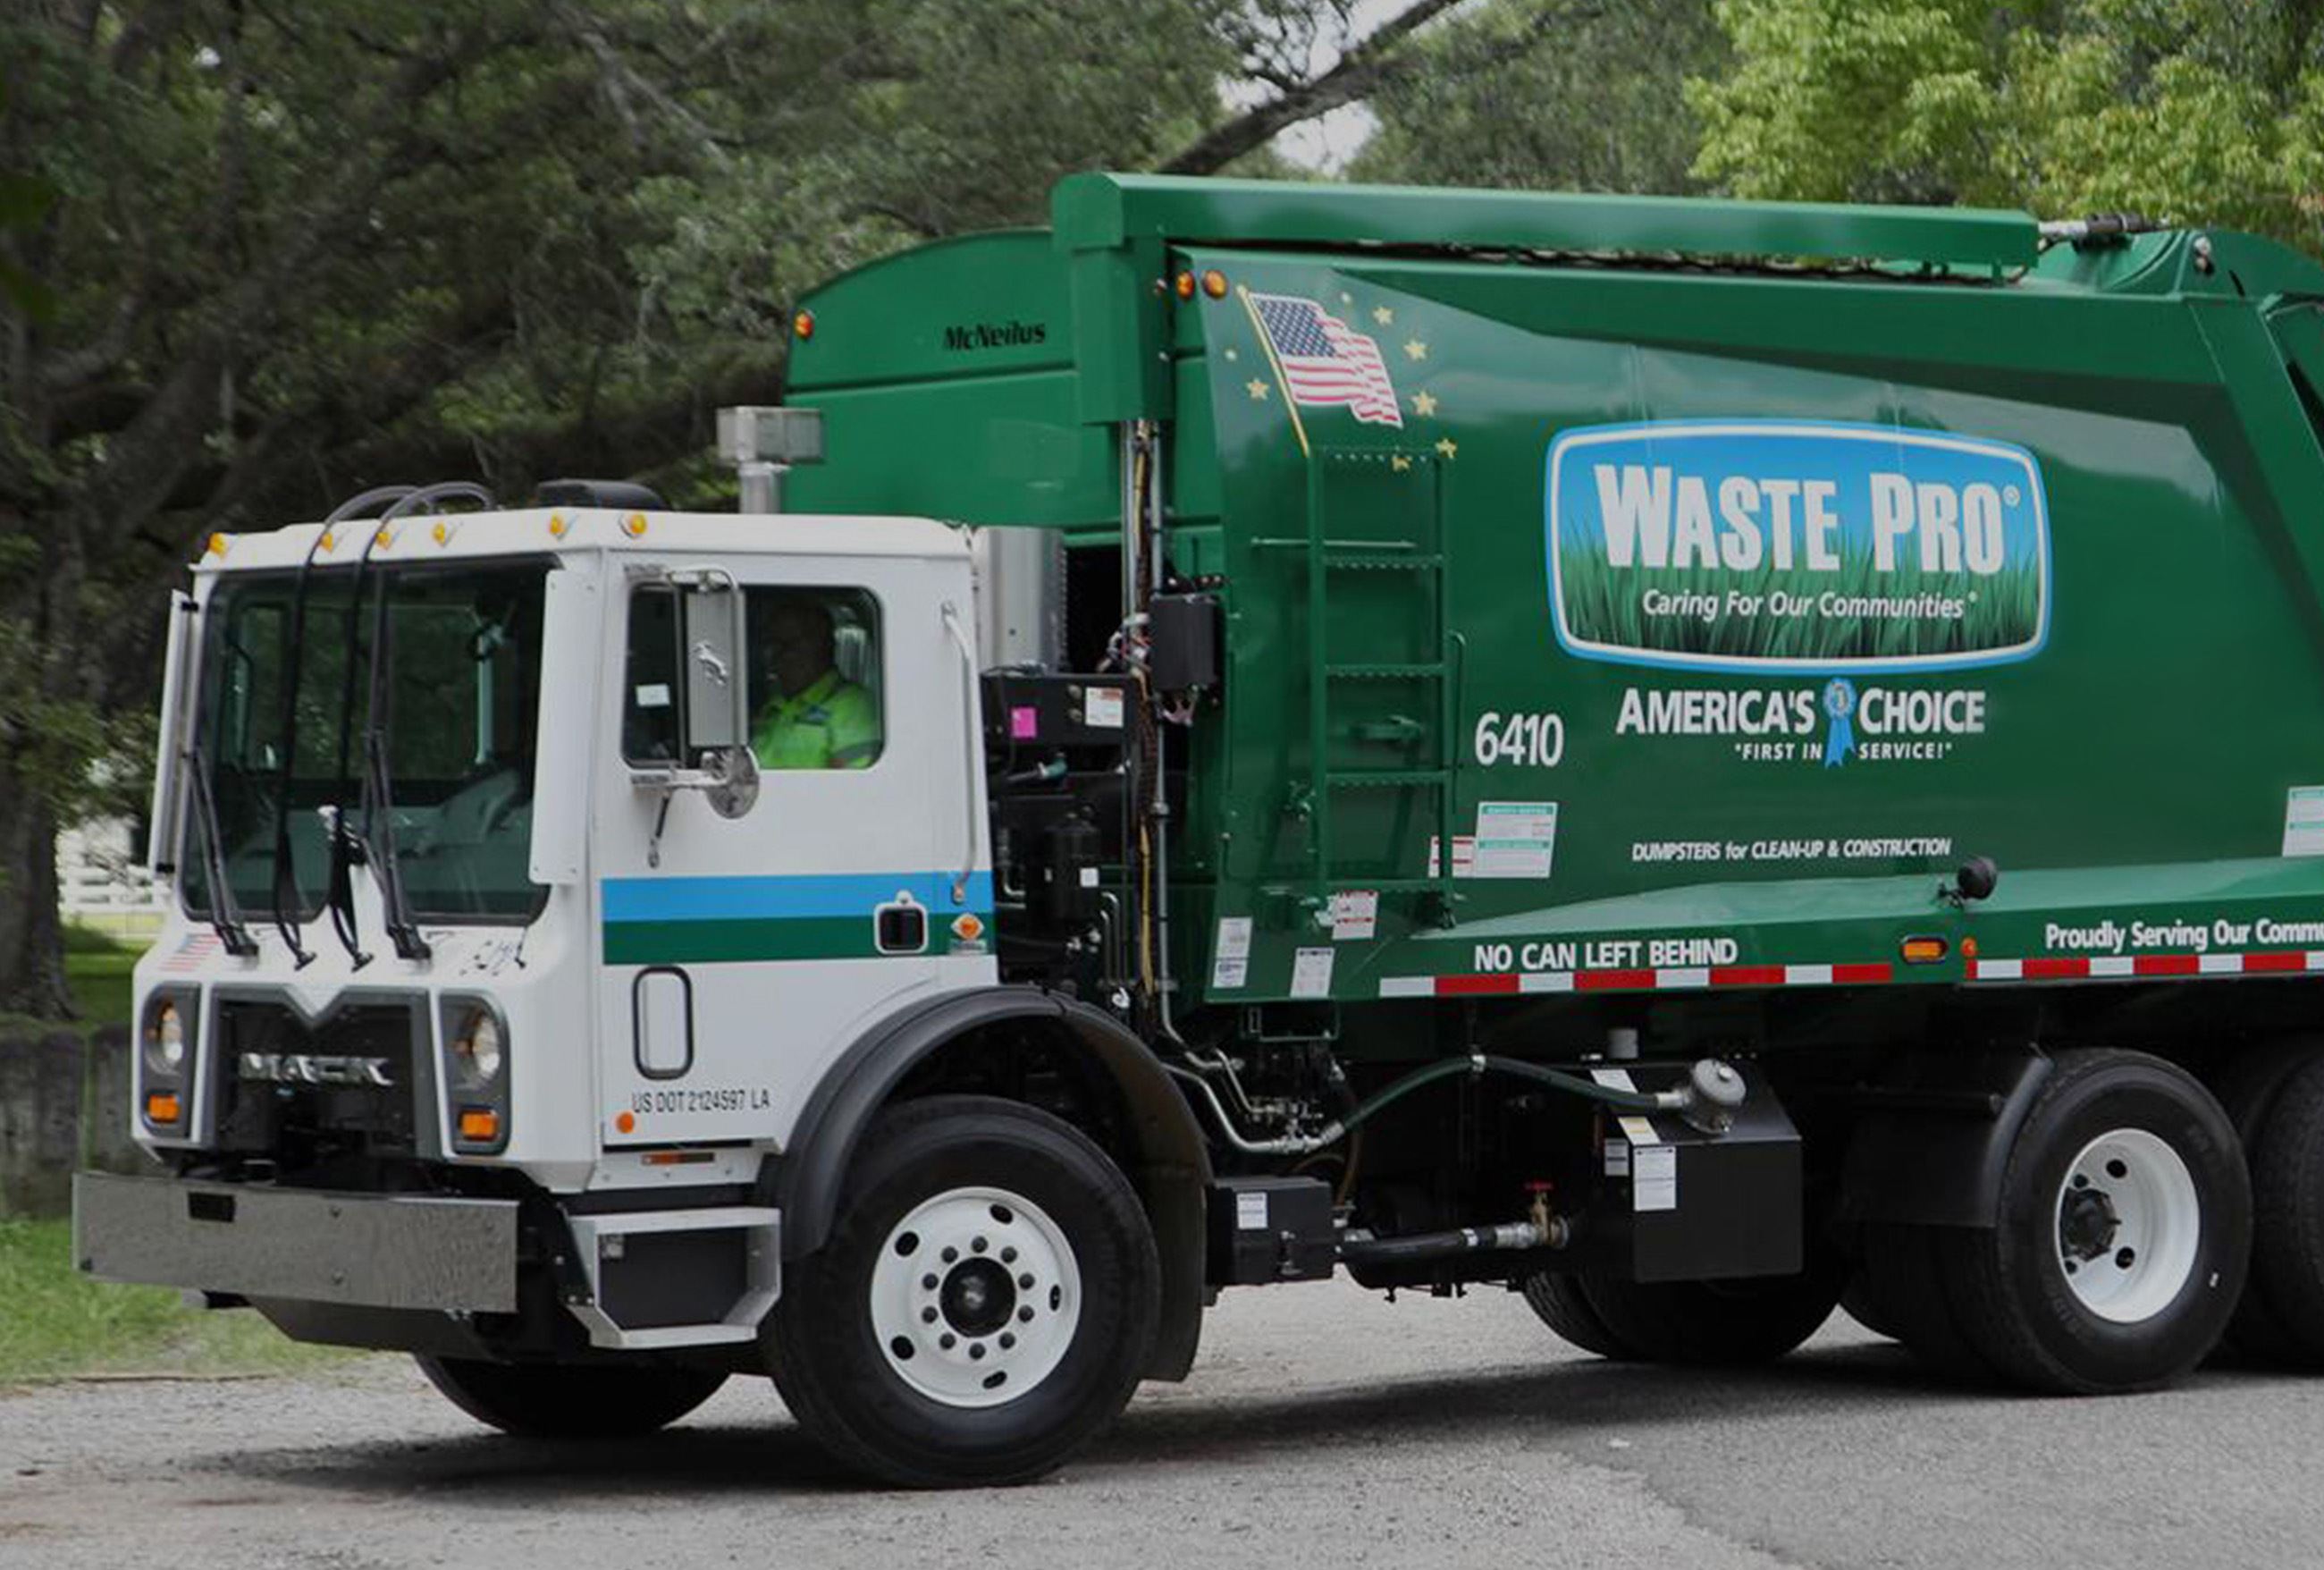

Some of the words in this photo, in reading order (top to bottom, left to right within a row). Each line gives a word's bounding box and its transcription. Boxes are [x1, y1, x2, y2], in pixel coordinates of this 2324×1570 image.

[945, 321, 1046, 350] McNeilus
[1594, 464, 1840, 571] WASTE
[1642, 589, 1718, 621] Caring
[1726, 591, 1763, 615] For
[1770, 591, 1813, 616] Our
[1819, 591, 1964, 619] Communities
[1616, 688, 1815, 734] AMERICA'S
[1859, 688, 1985, 733] CHOICE
[1475, 713, 1564, 766] 6410
[1803, 743, 1823, 759] IN
[1632, 843, 1721, 861] DUMPSTERS
[1726, 841, 1747, 860] for
[1751, 840, 1824, 859] CLEAN-UP
[1827, 840, 1839, 857] &
[1843, 838, 1951, 857] CONSTRUCTION
[2045, 921, 2126, 954] Proudly
[2132, 919, 2209, 952] Serving
[2213, 920, 2251, 945] Our
[1475, 945, 1512, 971] NO
[1521, 943, 1577, 970] CAN
[1586, 941, 1641, 967] LEFT
[1649, 939, 1738, 966] BEHIND
[633, 1093, 653, 1113] US
[657, 1092, 685, 1112] DOT
[688, 1088, 745, 1111] 2124597
[752, 1088, 770, 1110] LA
